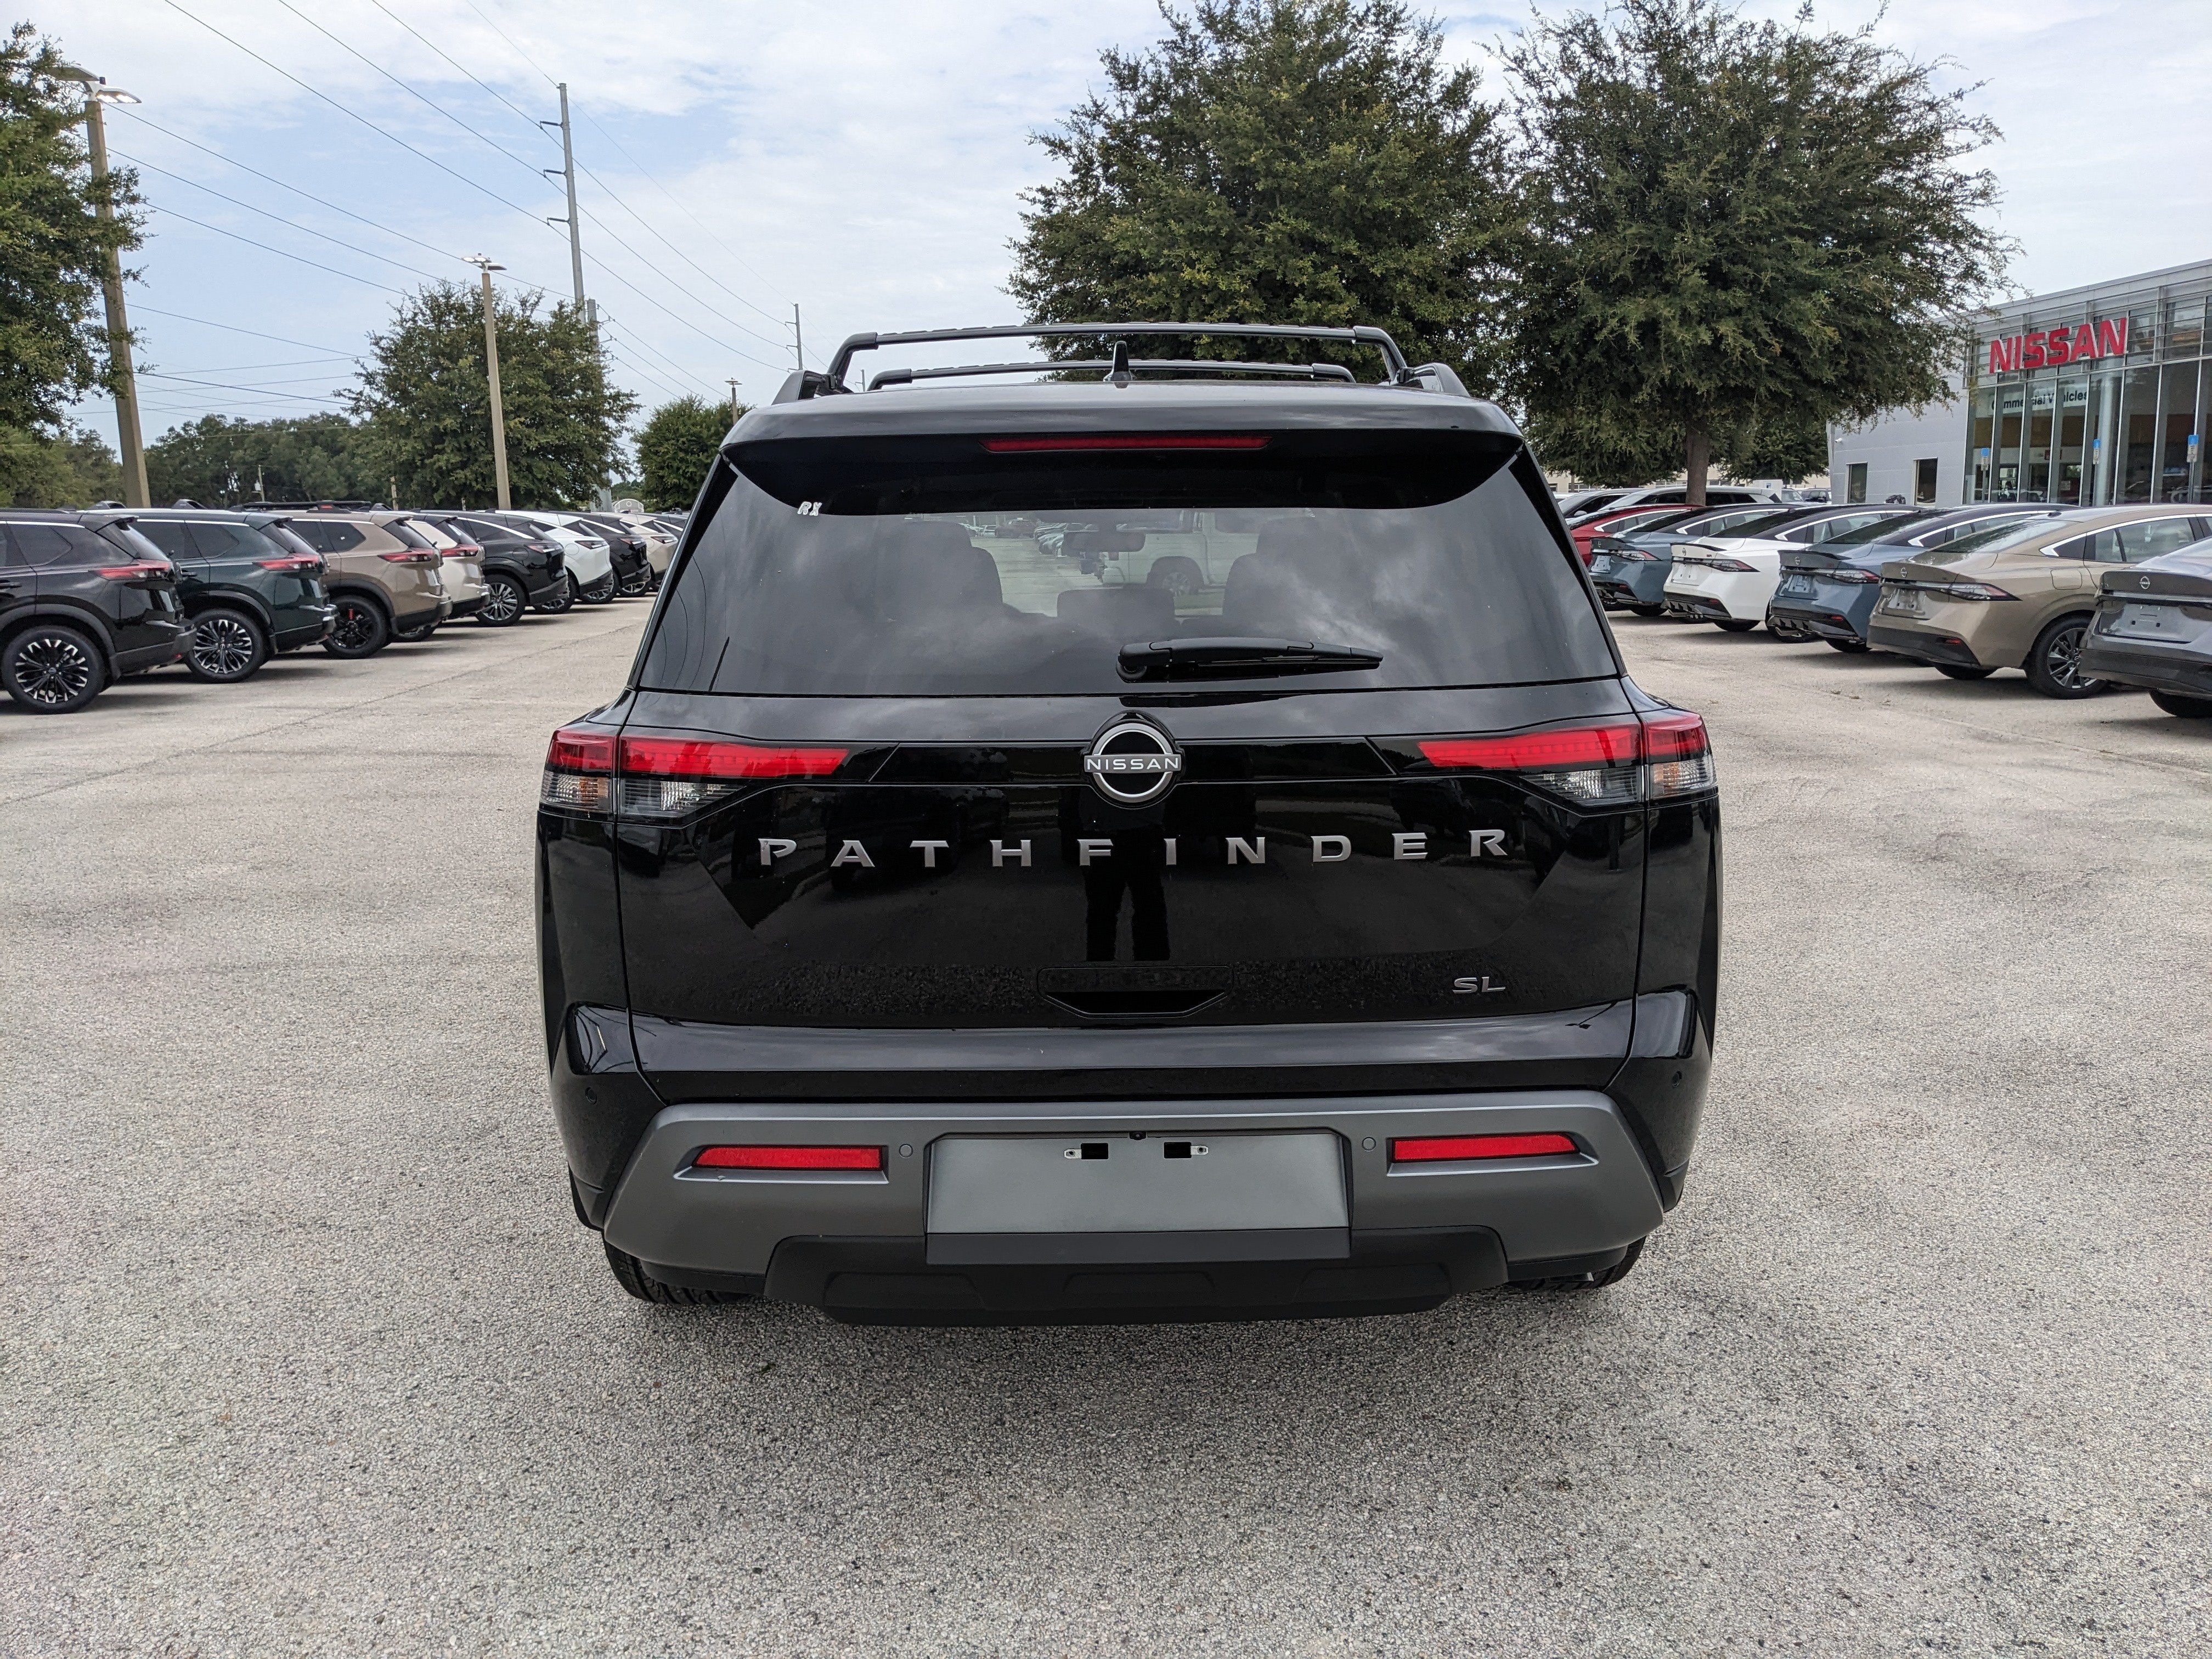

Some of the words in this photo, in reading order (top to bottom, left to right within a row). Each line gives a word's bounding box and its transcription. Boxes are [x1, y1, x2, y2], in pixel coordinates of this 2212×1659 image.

[1990, 318, 2128, 373] NISSAN
[1991, 394, 2045, 410] mmeial
[2048, 390, 2087, 404] Vicles
[1087, 757, 1178, 770] NISSAN
[759, 829, 1506, 868] PATHFINDER
[1452, 977, 1505, 994] SL
